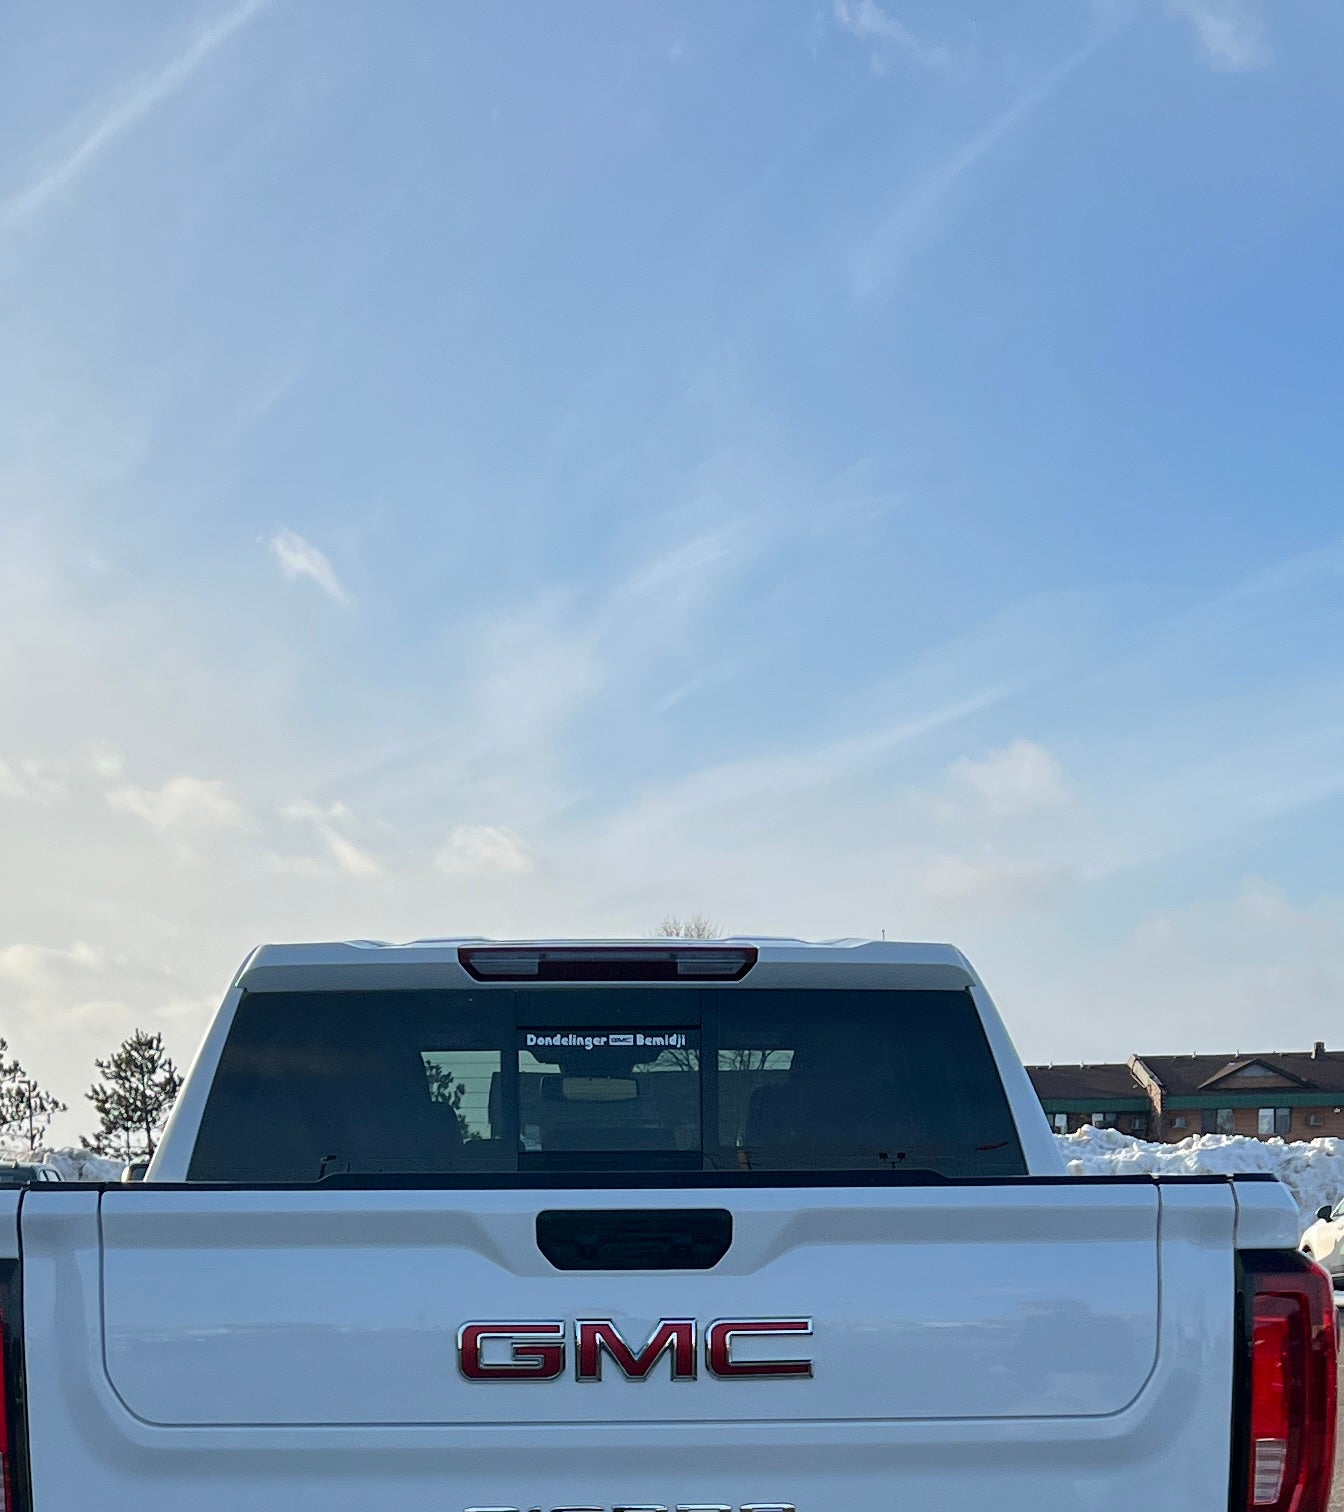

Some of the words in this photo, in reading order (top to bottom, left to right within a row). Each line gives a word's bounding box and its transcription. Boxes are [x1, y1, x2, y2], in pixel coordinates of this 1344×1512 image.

[526, 1034, 607, 1050] Dondelinger
[636, 1034, 686, 1048] Bemidji
[457, 1316, 814, 1383] GMC
